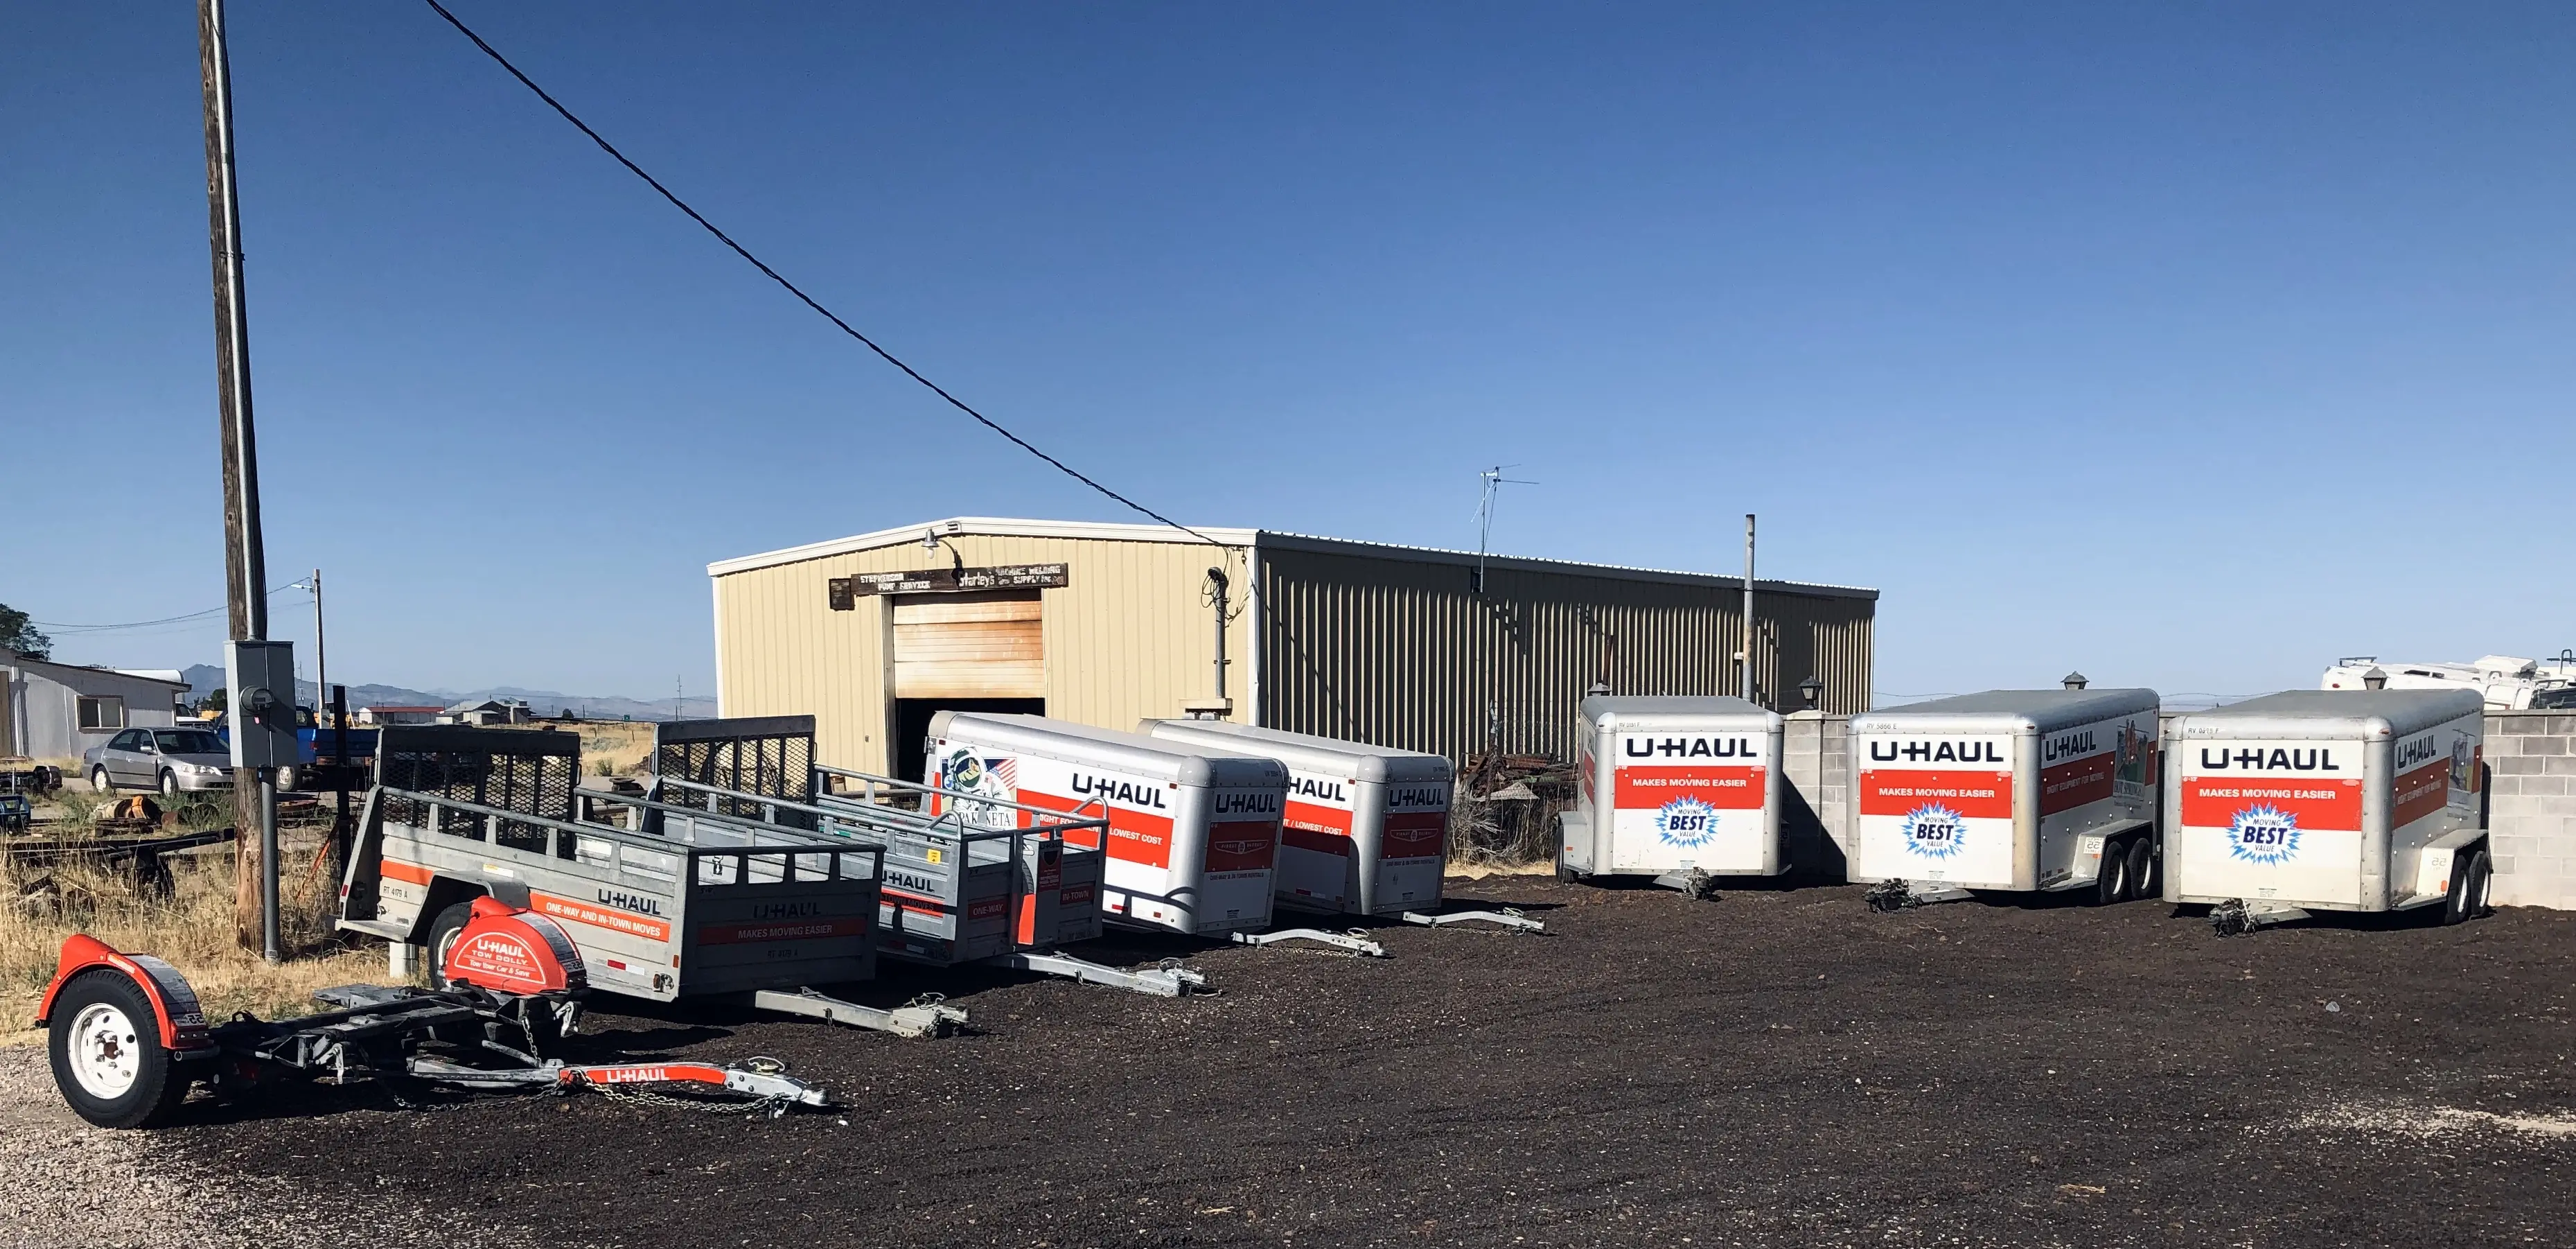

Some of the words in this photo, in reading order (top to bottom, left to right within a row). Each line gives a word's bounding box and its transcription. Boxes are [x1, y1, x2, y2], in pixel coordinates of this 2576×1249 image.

[1013, 575, 1039, 584] SUPPLY
[1626, 738, 1758, 758] U-HAUL
[1871, 742, 2004, 762] U-HAUL
[2046, 731, 2097, 761] U-HAUL
[2398, 735, 2436, 769] U-HAUL
[2202, 748, 2339, 770] U-HAUL
[1073, 773, 1166, 809] U-HAUL
[1287, 776, 1346, 801] HAUL
[1632, 778, 1667, 787] MAKES
[1669, 778, 1711, 787] MOVING
[1712, 779, 1747, 787] EASIER
[1389, 788, 1444, 806] U-HAUL
[1879, 787, 1913, 796] MAKES
[1915, 788, 1957, 797] MOVING
[1959, 789, 1995, 798] EASIER
[2199, 789, 2240, 797] MAKES
[2242, 789, 2291, 798] MOVING
[2294, 790, 2336, 799] EASIER
[1215, 794, 1277, 813] U-HAUL
[1296, 821, 1323, 832] LOWEST
[1324, 826, 1343, 835] COST
[1669, 815, 1707, 830] BEST
[1109, 828, 1140, 841] LOWEST
[1141, 834, 1163, 845] COST
[1916, 823, 1955, 840] BEST
[2243, 826, 2288, 845] BEST
[383, 886, 390, 894] RT
[391, 887, 403, 897] 4179
[404, 889, 408, 898] A
[1062, 890, 1089, 901] IN-TOWN
[598, 888, 661, 915] U-HAUL
[908, 900, 935, 911] MOVES
[973, 903, 1003, 916] ONE-WAY
[546, 901, 581, 918] ONE-WAY
[581, 910, 597, 922] AND
[598, 914, 632, 930] IN-TOWN
[633, 922, 661, 937] MOVES
[738, 927, 768, 939] MAKES
[769, 926, 803, 938] MOVING
[804, 925, 832, 934] EASIER
[477, 938, 525, 958] U-HAUL
[472, 950, 493, 959] TOW
[495, 954, 528, 966] DOLLY
[469, 959, 482, 968] Tow
[482, 961, 496, 971] Your
[515, 969, 530, 978] Save
[606, 1068, 670, 1083] U-HAUL
